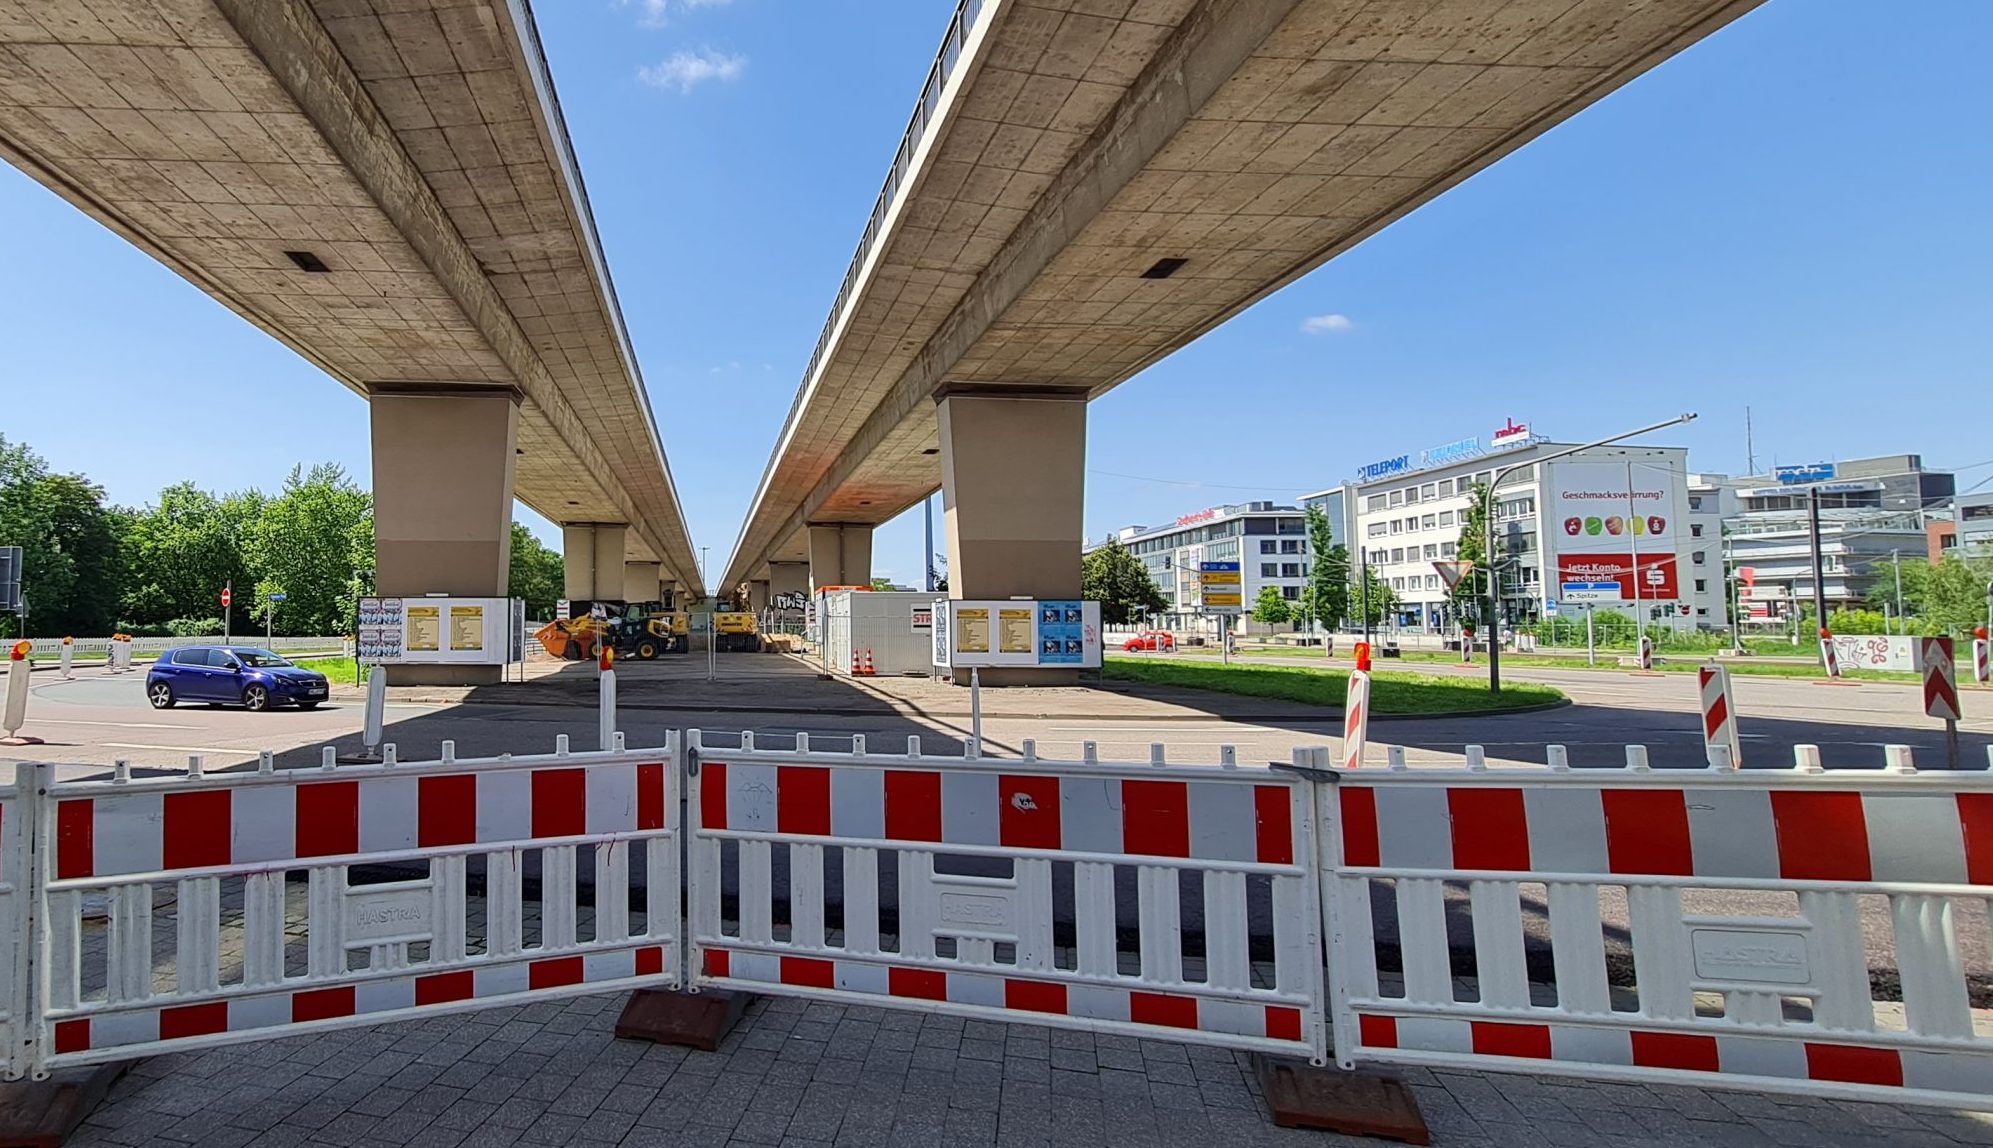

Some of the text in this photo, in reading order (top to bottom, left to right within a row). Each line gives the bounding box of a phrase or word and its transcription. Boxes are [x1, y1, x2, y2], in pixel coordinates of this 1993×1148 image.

[1366, 455, 1409, 477] TELEPORT
[1562, 490, 1664, 500] Geschmacksveirrung?
[1567, 563, 1620, 572] Jetzt Konto
[1567, 573, 1614, 582] wechseln!
[357, 906, 420, 926] HASTRA
